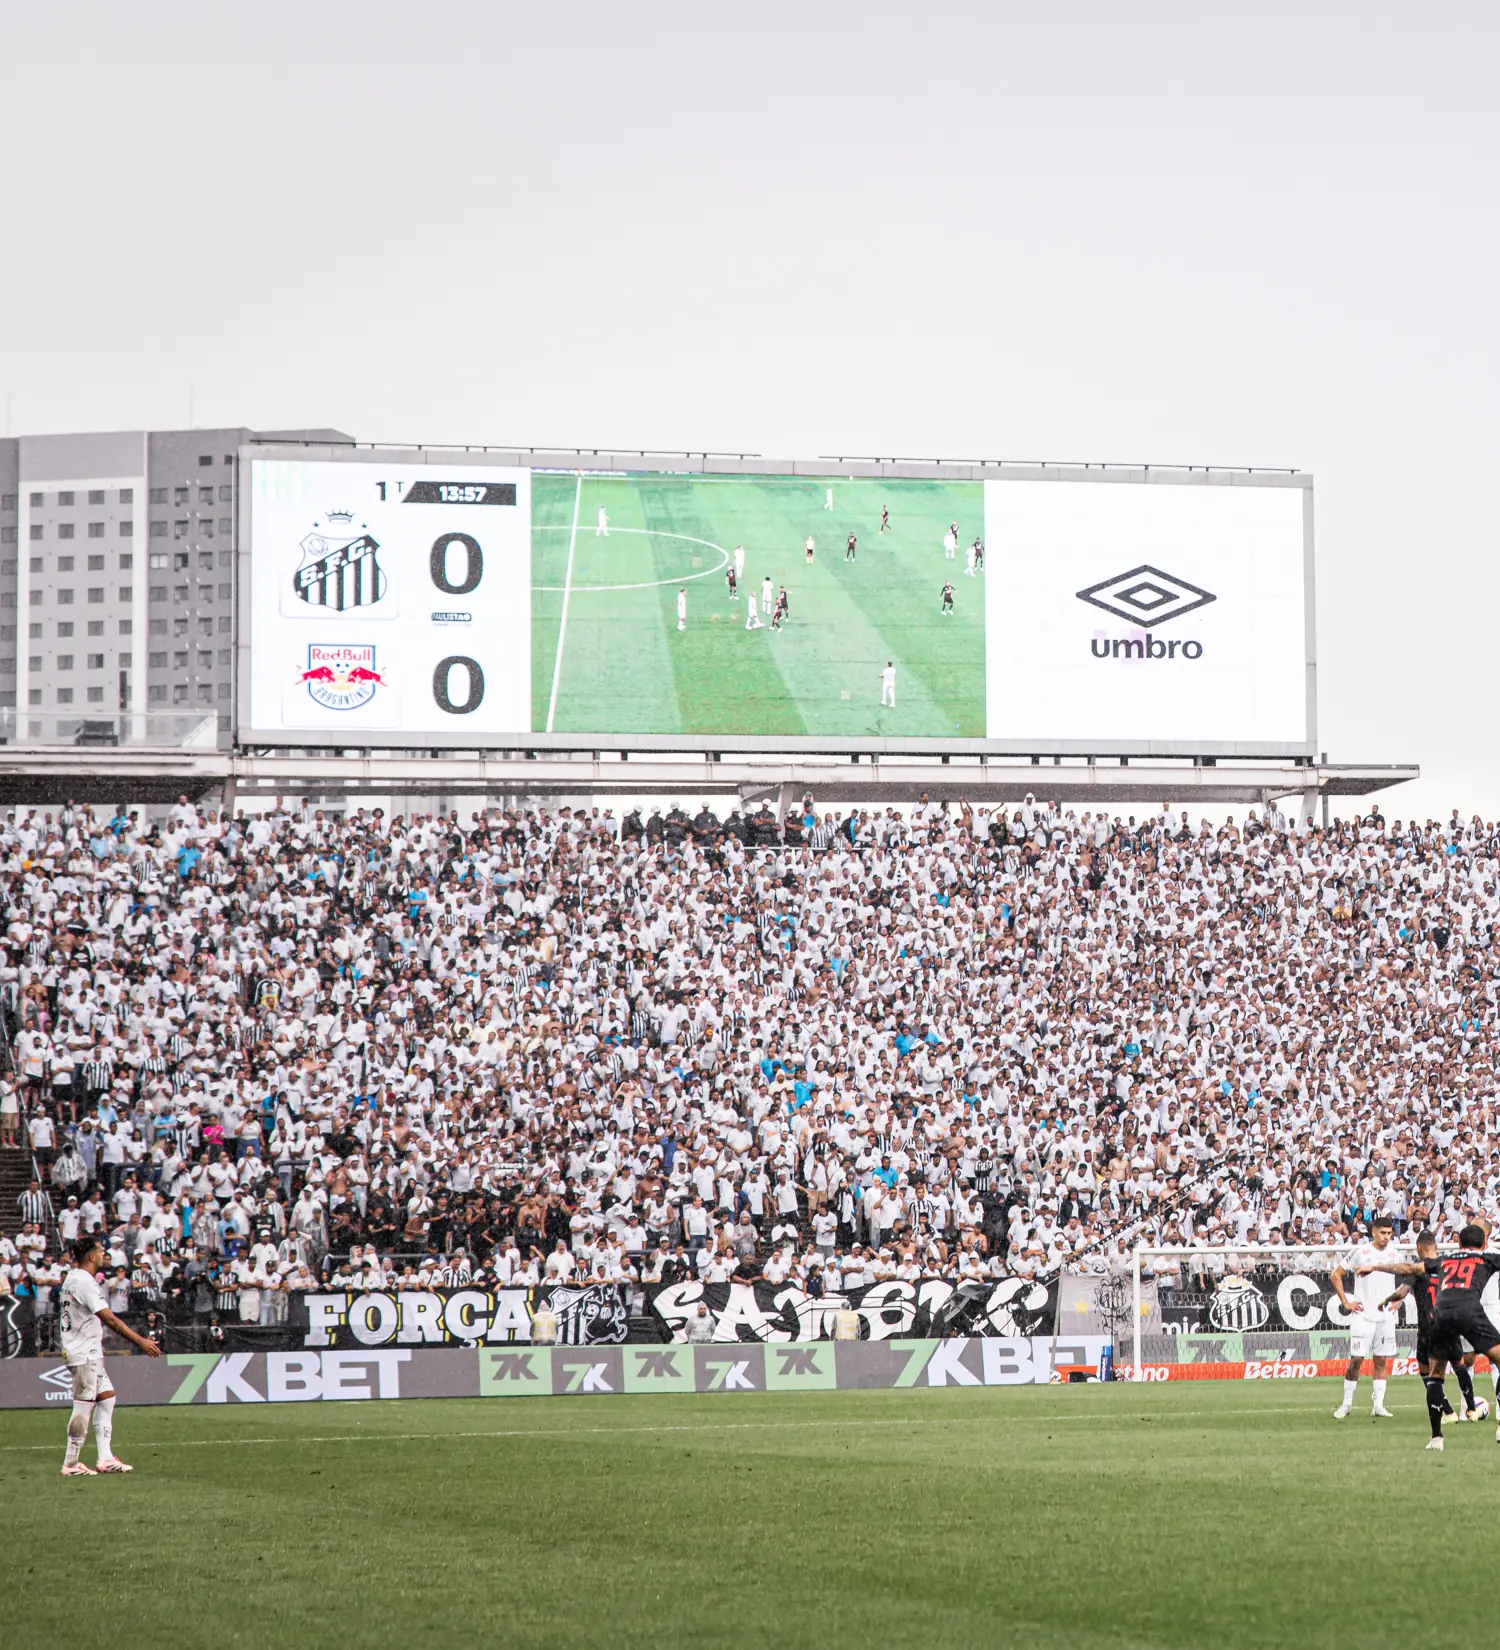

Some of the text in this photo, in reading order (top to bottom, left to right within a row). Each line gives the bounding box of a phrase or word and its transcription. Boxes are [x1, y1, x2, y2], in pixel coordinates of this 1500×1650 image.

[439, 485, 487, 502] 13:57
[429, 532, 484, 595] 0
[312, 648, 371, 661] Red Bull
[1091, 633, 1203, 660] umbro
[432, 655, 486, 715] 0
[1441, 1259, 1476, 1291] 29
[304, 1290, 535, 1348] FORÇA
[490, 1353, 540, 1381] 7K
[634, 1350, 682, 1378] 7K
[705, 1360, 756, 1390] 7K
[776, 1348, 824, 1376] 7K
[1243, 1361, 1318, 1380] Betano
[166, 1349, 412, 1404] 7KBET
[562, 1362, 614, 1392] 7K
[45, 1390, 74, 1401] umb
